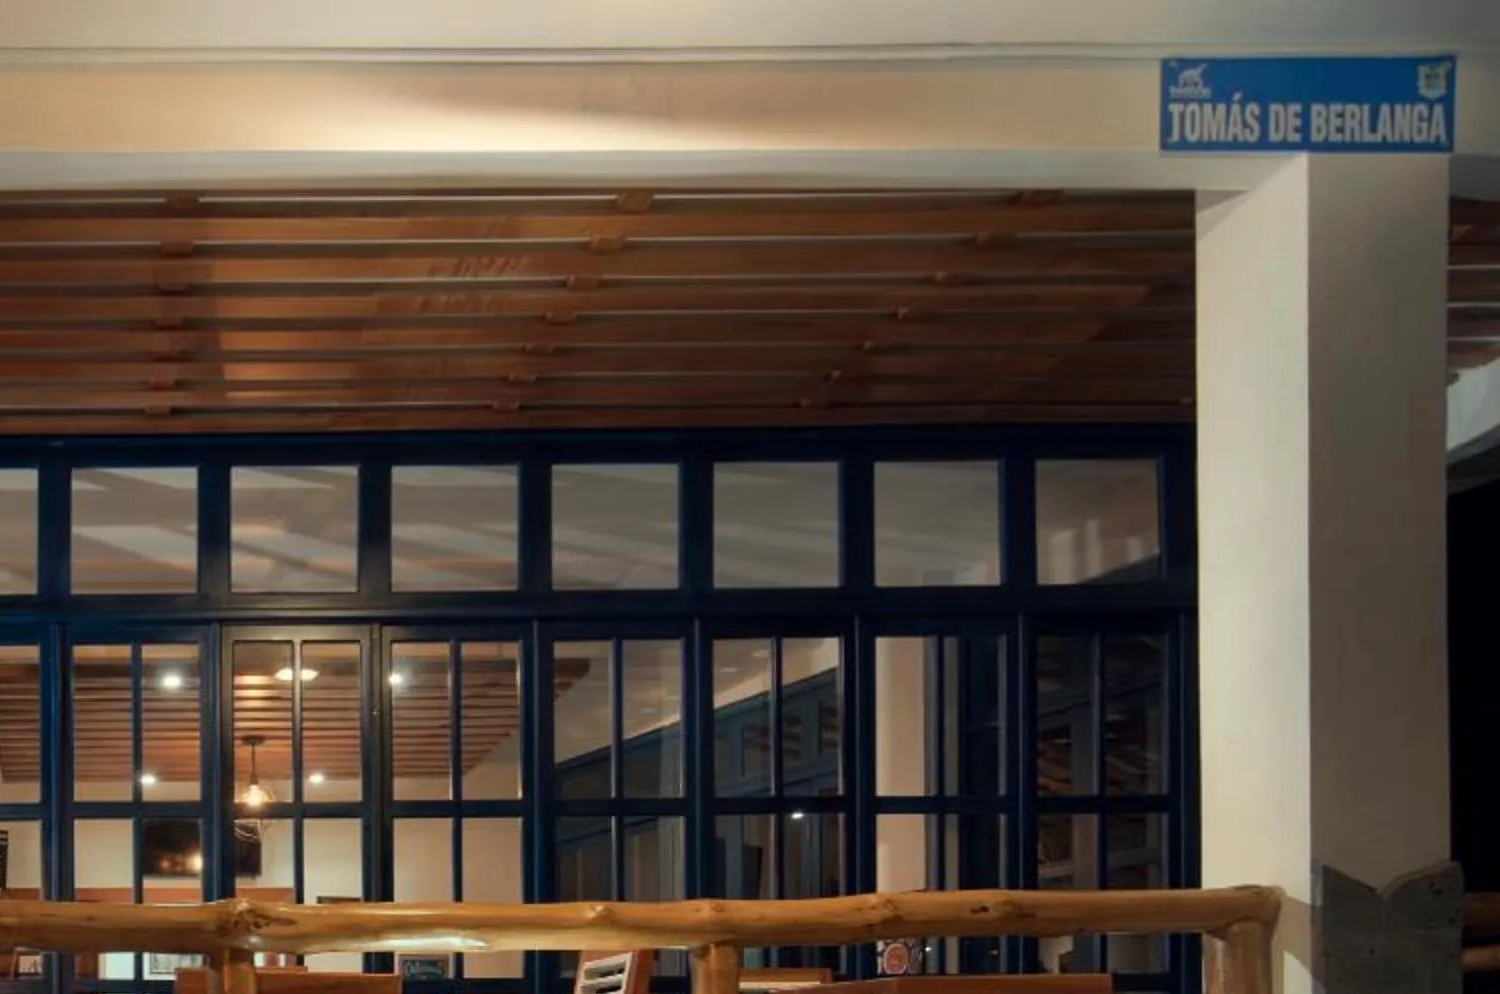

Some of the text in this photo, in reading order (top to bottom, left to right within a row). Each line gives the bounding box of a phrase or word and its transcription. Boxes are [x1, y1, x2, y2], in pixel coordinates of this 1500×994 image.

[1168, 92, 1447, 143] TOMÁS DE BERLANGA
